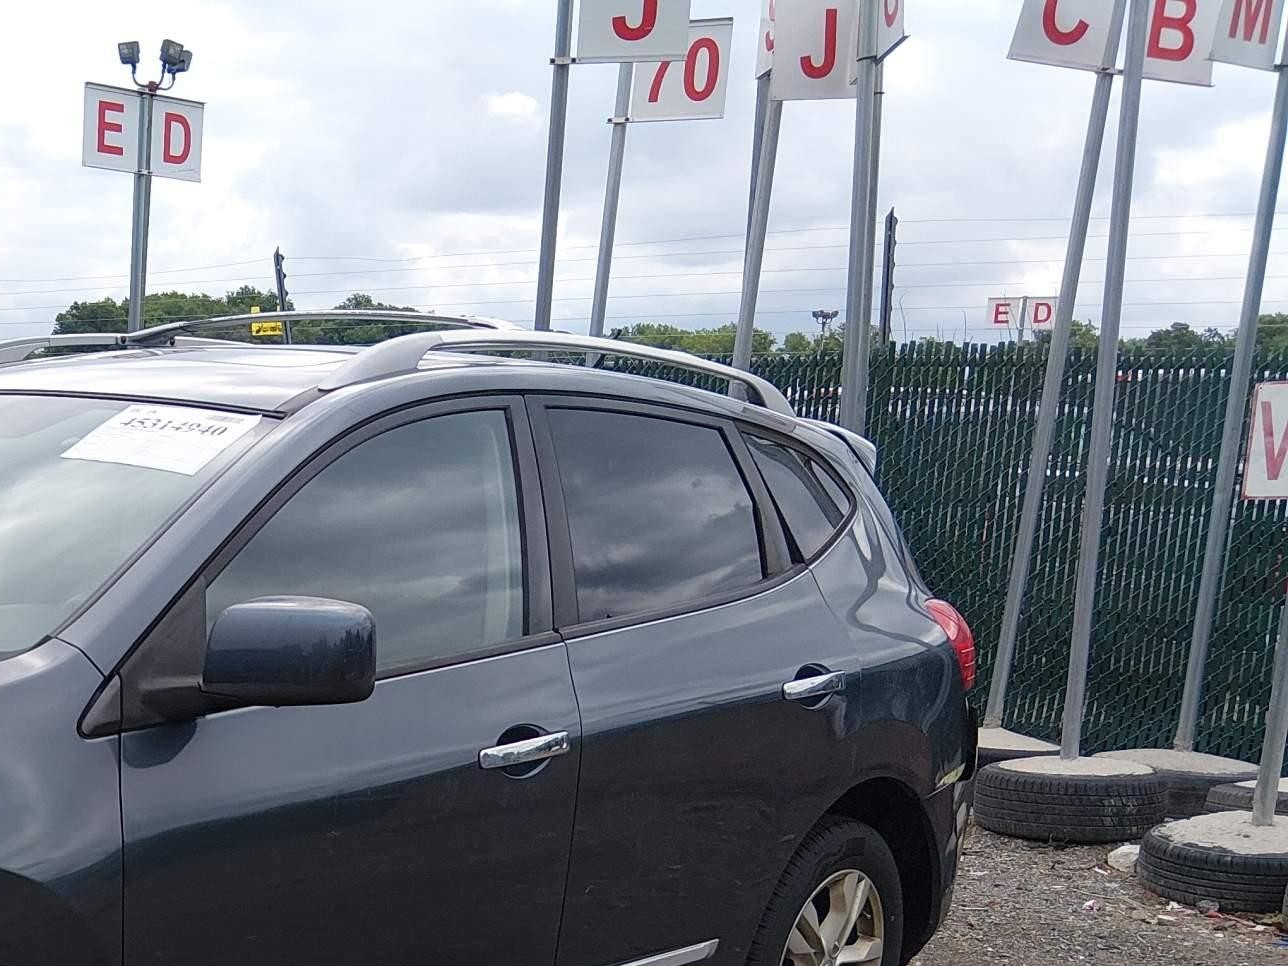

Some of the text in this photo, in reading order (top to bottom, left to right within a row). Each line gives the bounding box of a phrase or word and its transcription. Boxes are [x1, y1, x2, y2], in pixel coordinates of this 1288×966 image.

[800, 8, 837, 79] J
[1042, 0, 1089, 45] C
[1146, 0, 1197, 61] B
[647, 37, 720, 102] 70
[97, 100, 192, 165] E D
[993, 302, 1052, 324] E D
